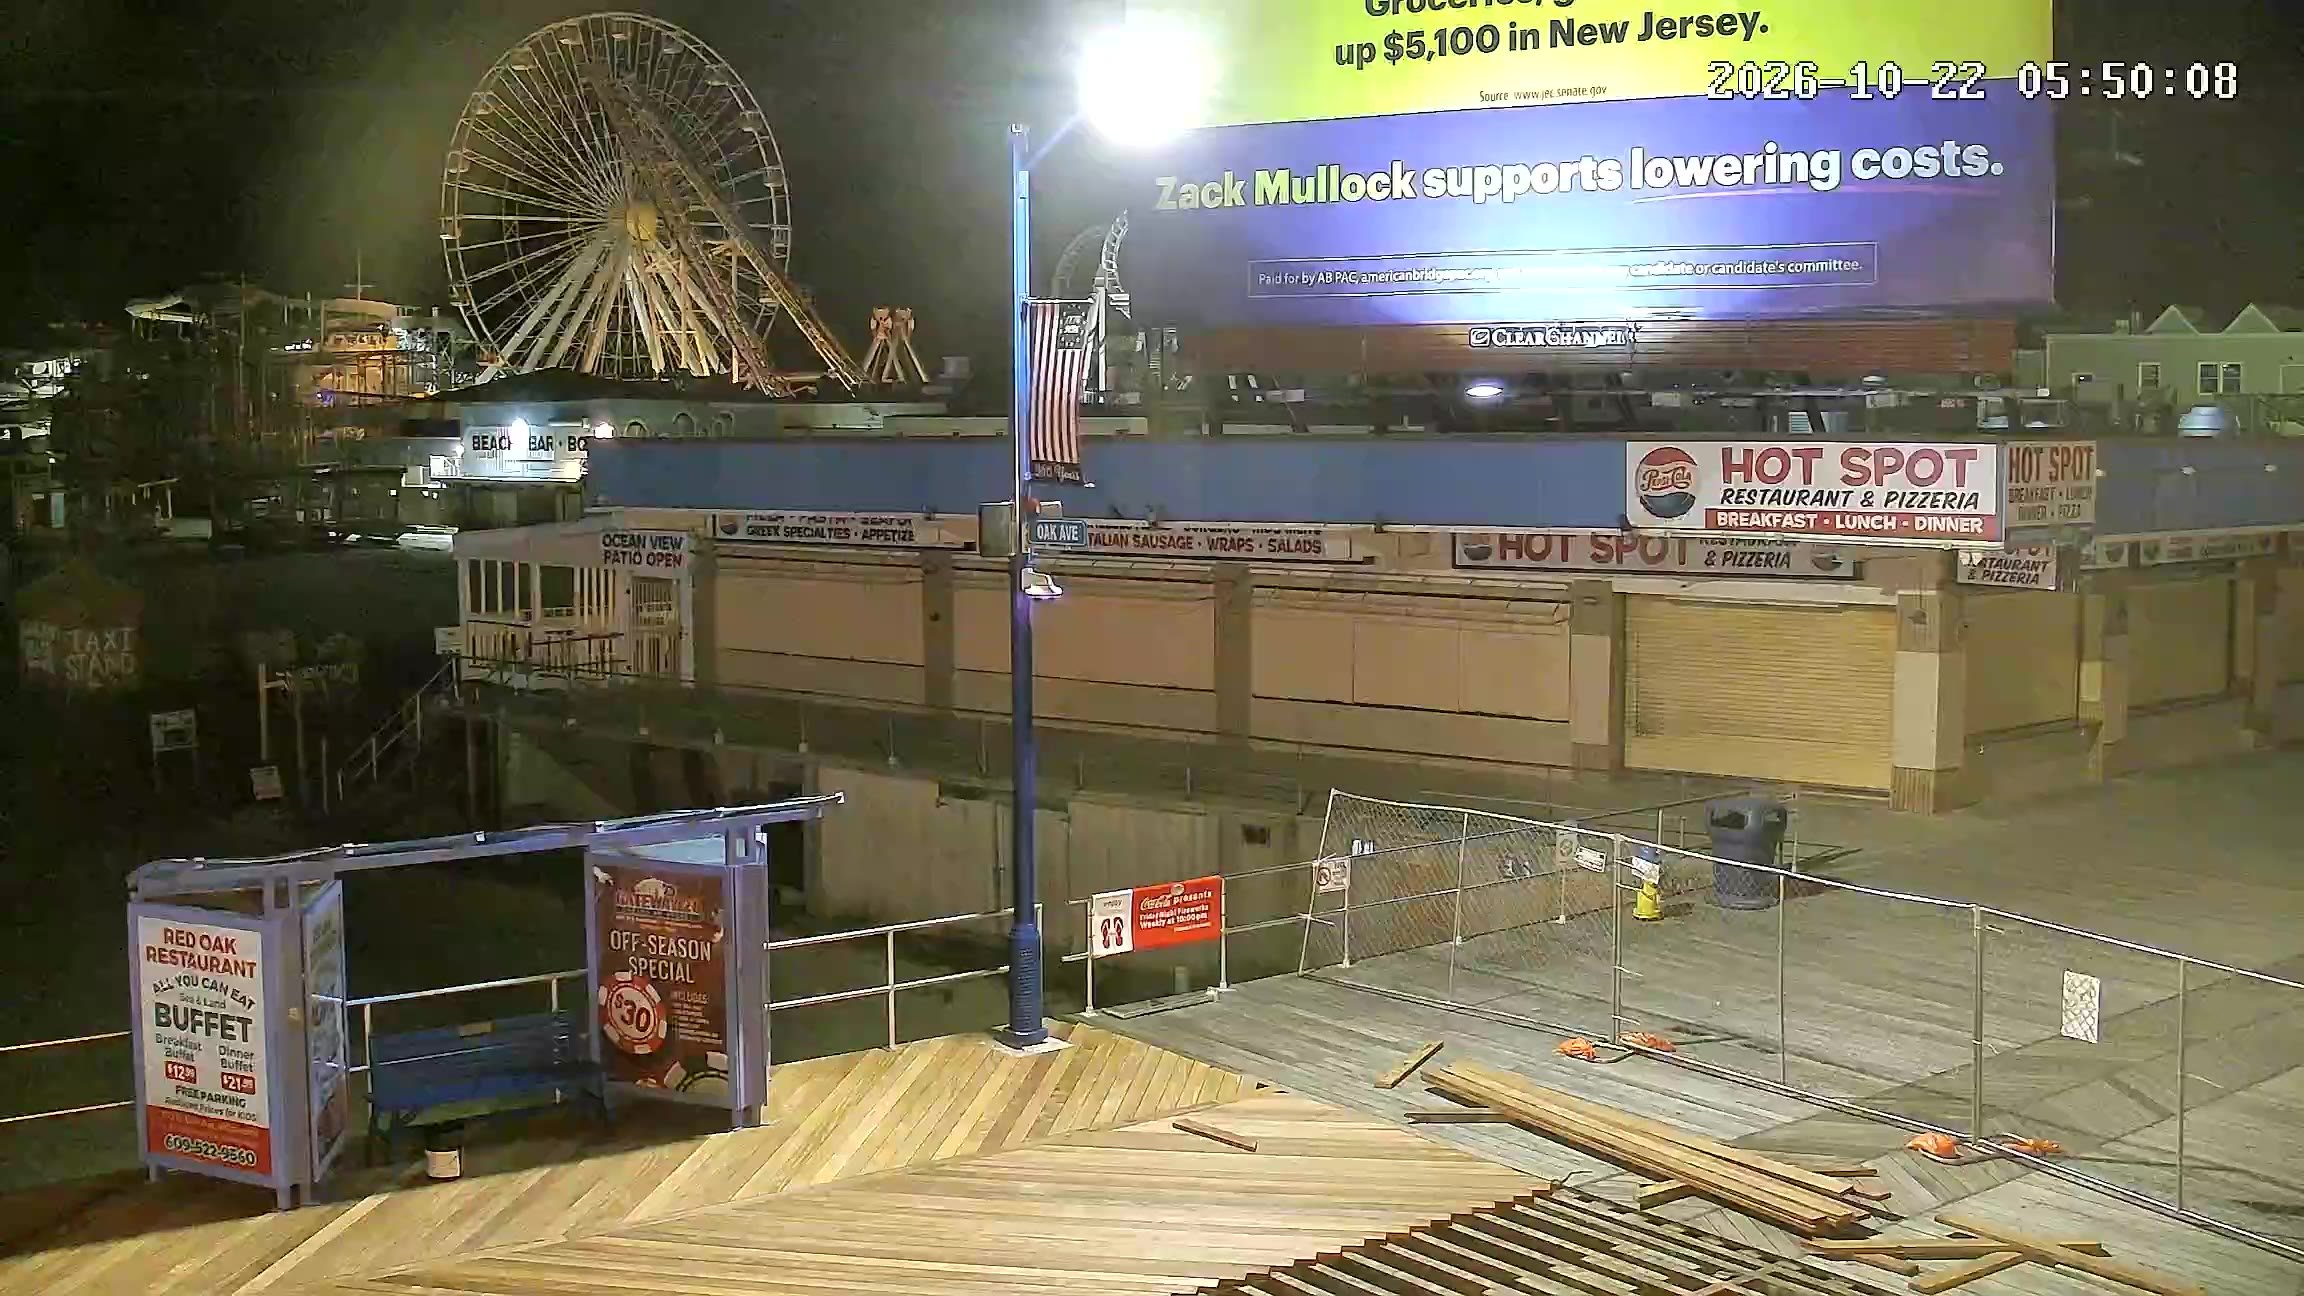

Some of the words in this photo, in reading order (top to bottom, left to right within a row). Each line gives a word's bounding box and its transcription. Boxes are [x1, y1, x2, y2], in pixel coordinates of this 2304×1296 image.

[1365, 0, 1541, 16] Groc,
[1334, 39, 1376, 70] up
[1383, 24, 1500, 65] $5,100
[1508, 21, 1541, 52] in
[1549, 17, 1628, 49] New
[1637, 9, 1769, 42] Jersey.
[1153, 170, 1249, 211] Zack
[1253, 159, 1418, 206] Mullock
[1421, 155, 1624, 204] supports
[1629, 141, 1842, 192] lowering
[1850, 140, 2004, 181] costs.
[1711, 260, 1785, 275] candidate's
[1787, 259, 1863, 273] committee.
[1258, 273, 1281, 285] Paid
[1283, 272, 1300, 284] for
[1301, 272, 1316, 288] by
[1317, 271, 1333, 284] AB
[1335, 270, 1359, 286] PAC,
[529, 435, 554, 451] BAR
[1720, 446, 1825, 485] HOT
[1839, 446, 1979, 488] SPOT
[2008, 446, 2044, 484] HOT
[2048, 445, 2095, 482] SPOT
[1720, 487, 1858, 509] RESTAURANT
[1862, 490, 1875, 507] &
[1884, 490, 1980, 511] PIZZERIA
[783, 526, 851, 540] SPECIALTIES
[1036, 522, 1059, 541] OAK
[1059, 524, 1079, 541] AVE
[1717, 510, 1819, 530] BREAKFAST
[1834, 513, 1898, 531] LUNCH
[1913, 514, 1984, 534] DINNER
[602, 533, 646, 549] OCEAN
[650, 535, 685, 550] VIEW
[1088, 532, 1129, 549] TALIAN
[1132, 533, 1194, 550] SAUSAGE
[1206, 535, 1255, 553] WRAPS
[1267, 538, 1323, 554] SALADS
[603, 549, 643, 566] PATIO
[646, 551, 684, 569] OPEN
[1704, 550, 1717, 567] &
[1722, 550, 1791, 569] PIZZERIA
[1983, 569, 2039, 585] PIZZERIA
[163, 927, 196, 949] RED
[199, 933, 238, 955] OAK
[609, 929, 712, 961] OFF-SEASON
[145, 945, 257, 979] RESTAURANT
[628, 955, 696, 984] SPECIAL
[152, 977, 174, 994] ALL
[173, 974, 199, 988] YOU
[201, 977, 229, 997] CAN
[230, 988, 257, 1010] EAT
[154, 1001, 253, 1043] BUFFET
[613, 993, 652, 1033] $30
[219, 1045, 255, 1060] Dinner
[220, 1057, 254, 1073] Buffet
[200, 1090, 248, 1109] PARKING
